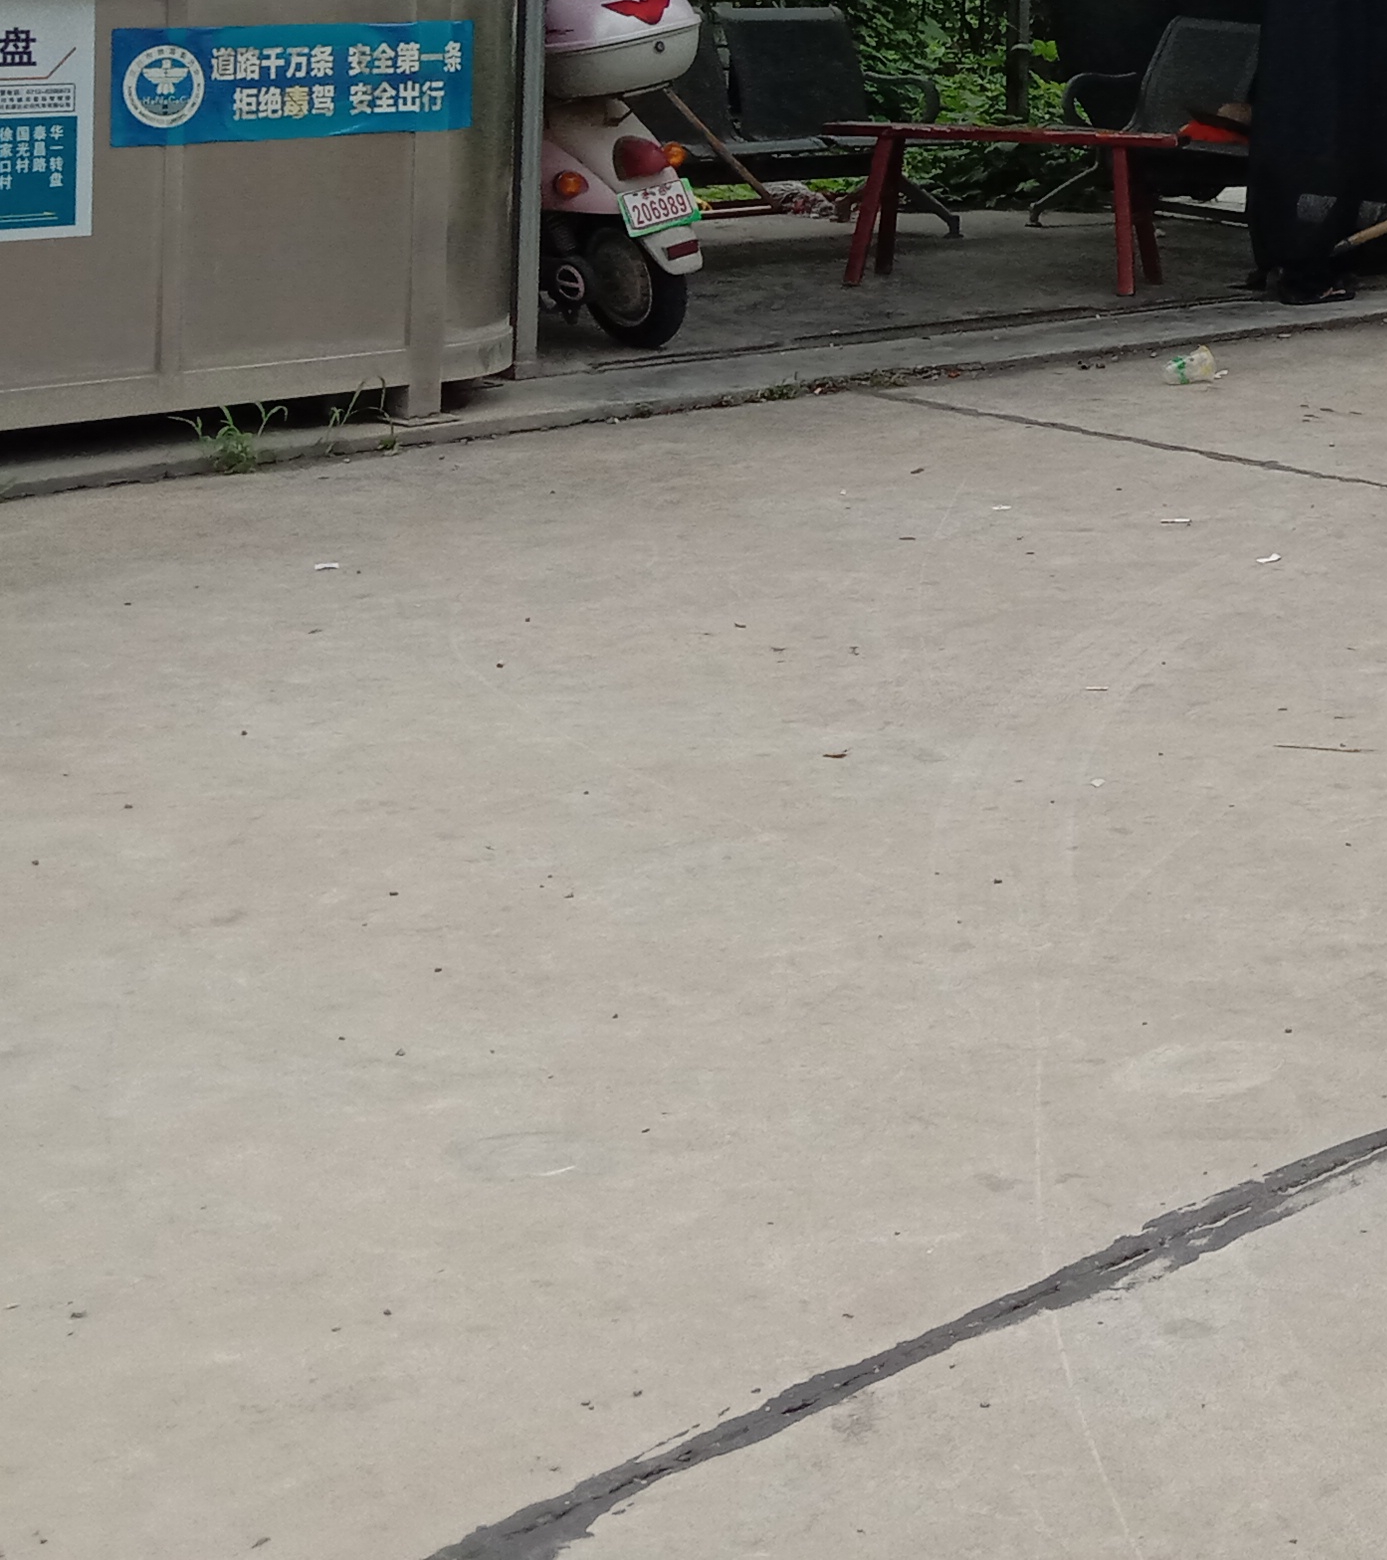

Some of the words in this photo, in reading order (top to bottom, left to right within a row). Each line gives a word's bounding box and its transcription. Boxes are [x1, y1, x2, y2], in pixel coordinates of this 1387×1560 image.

[0, 27, 37, 67] 盘
[211, 44, 334, 81] 道路千万条
[348, 40, 462, 76] 安全第一条
[233, 84, 335, 120] 拒绝毒驾
[349, 80, 445, 115] 安全出行
[632, 193, 687, 225] 206989
